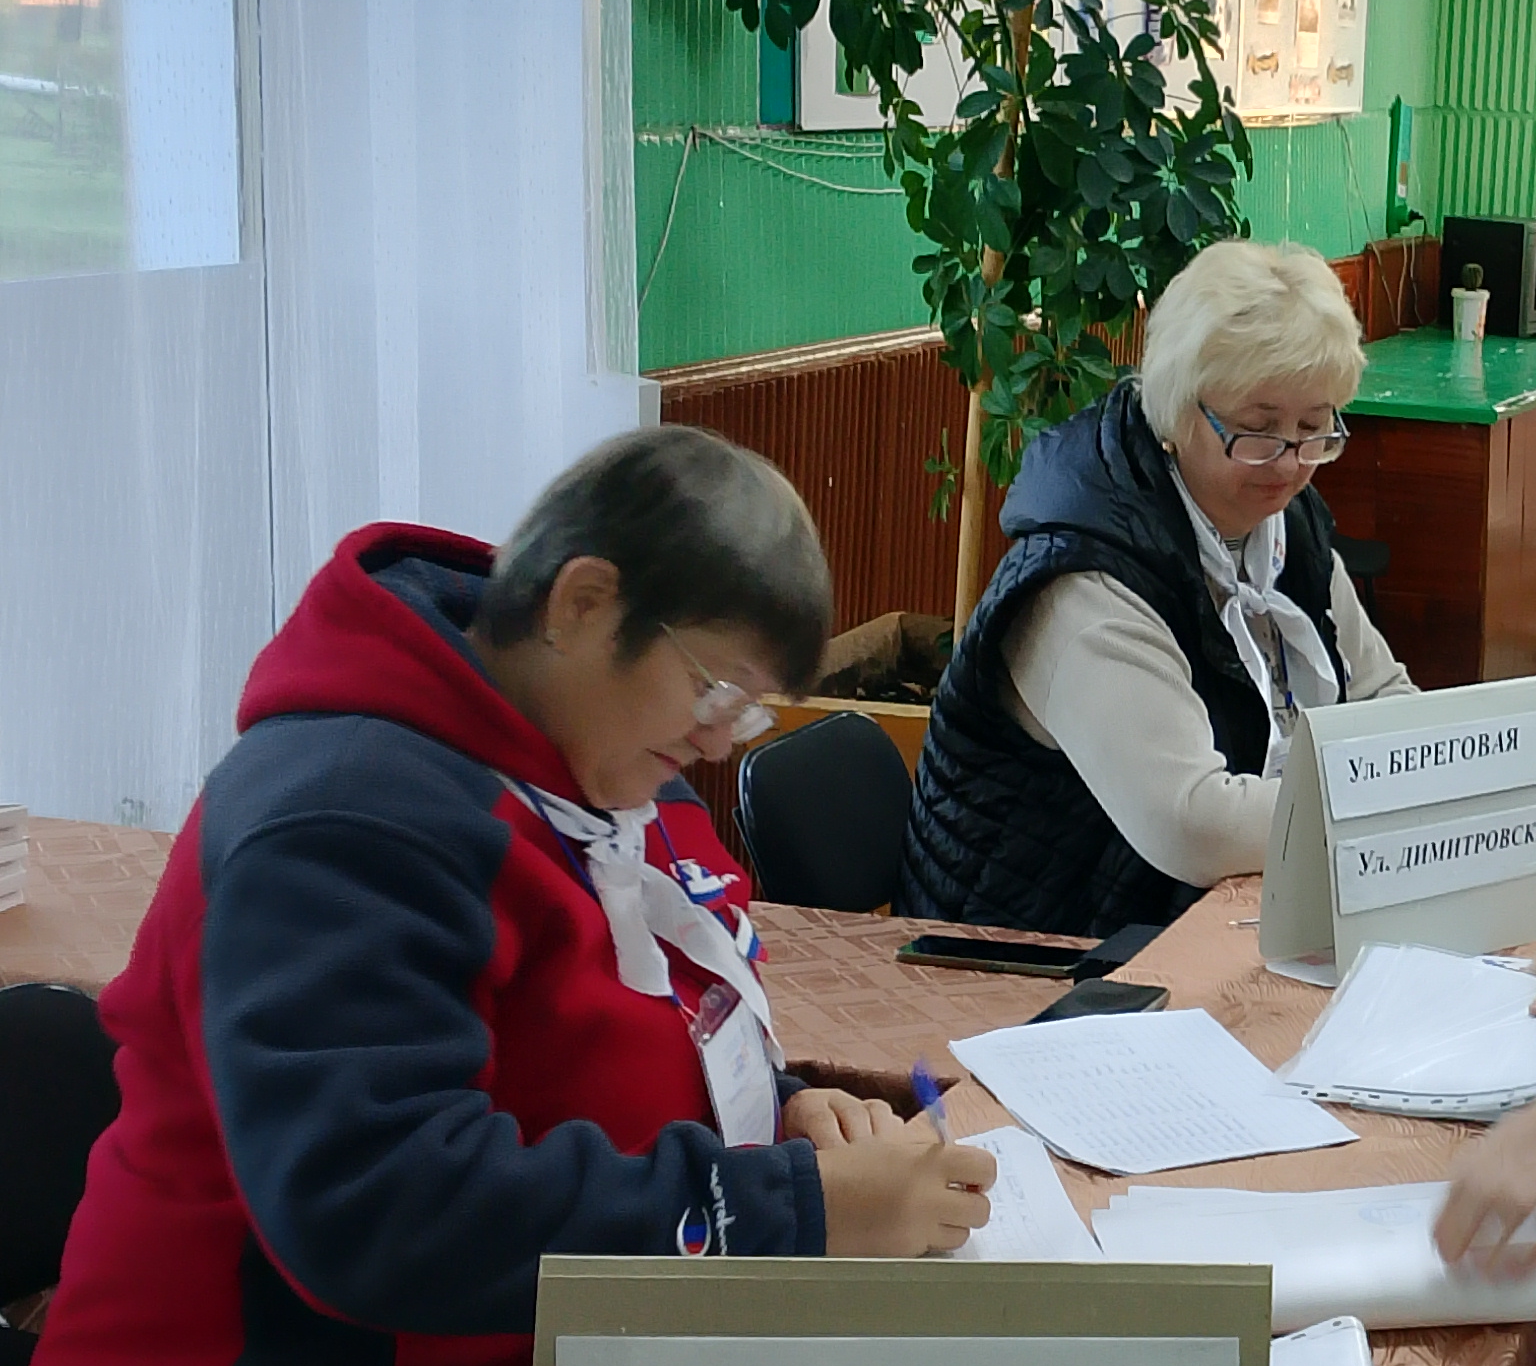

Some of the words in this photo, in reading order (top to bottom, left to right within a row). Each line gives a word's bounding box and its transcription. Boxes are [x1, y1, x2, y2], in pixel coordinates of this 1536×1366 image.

[1348, 757, 1382, 785] Ул.
[1388, 726, 1520, 775] БЕРЕГОВАЯ
[1357, 849, 1391, 878] Ул.
